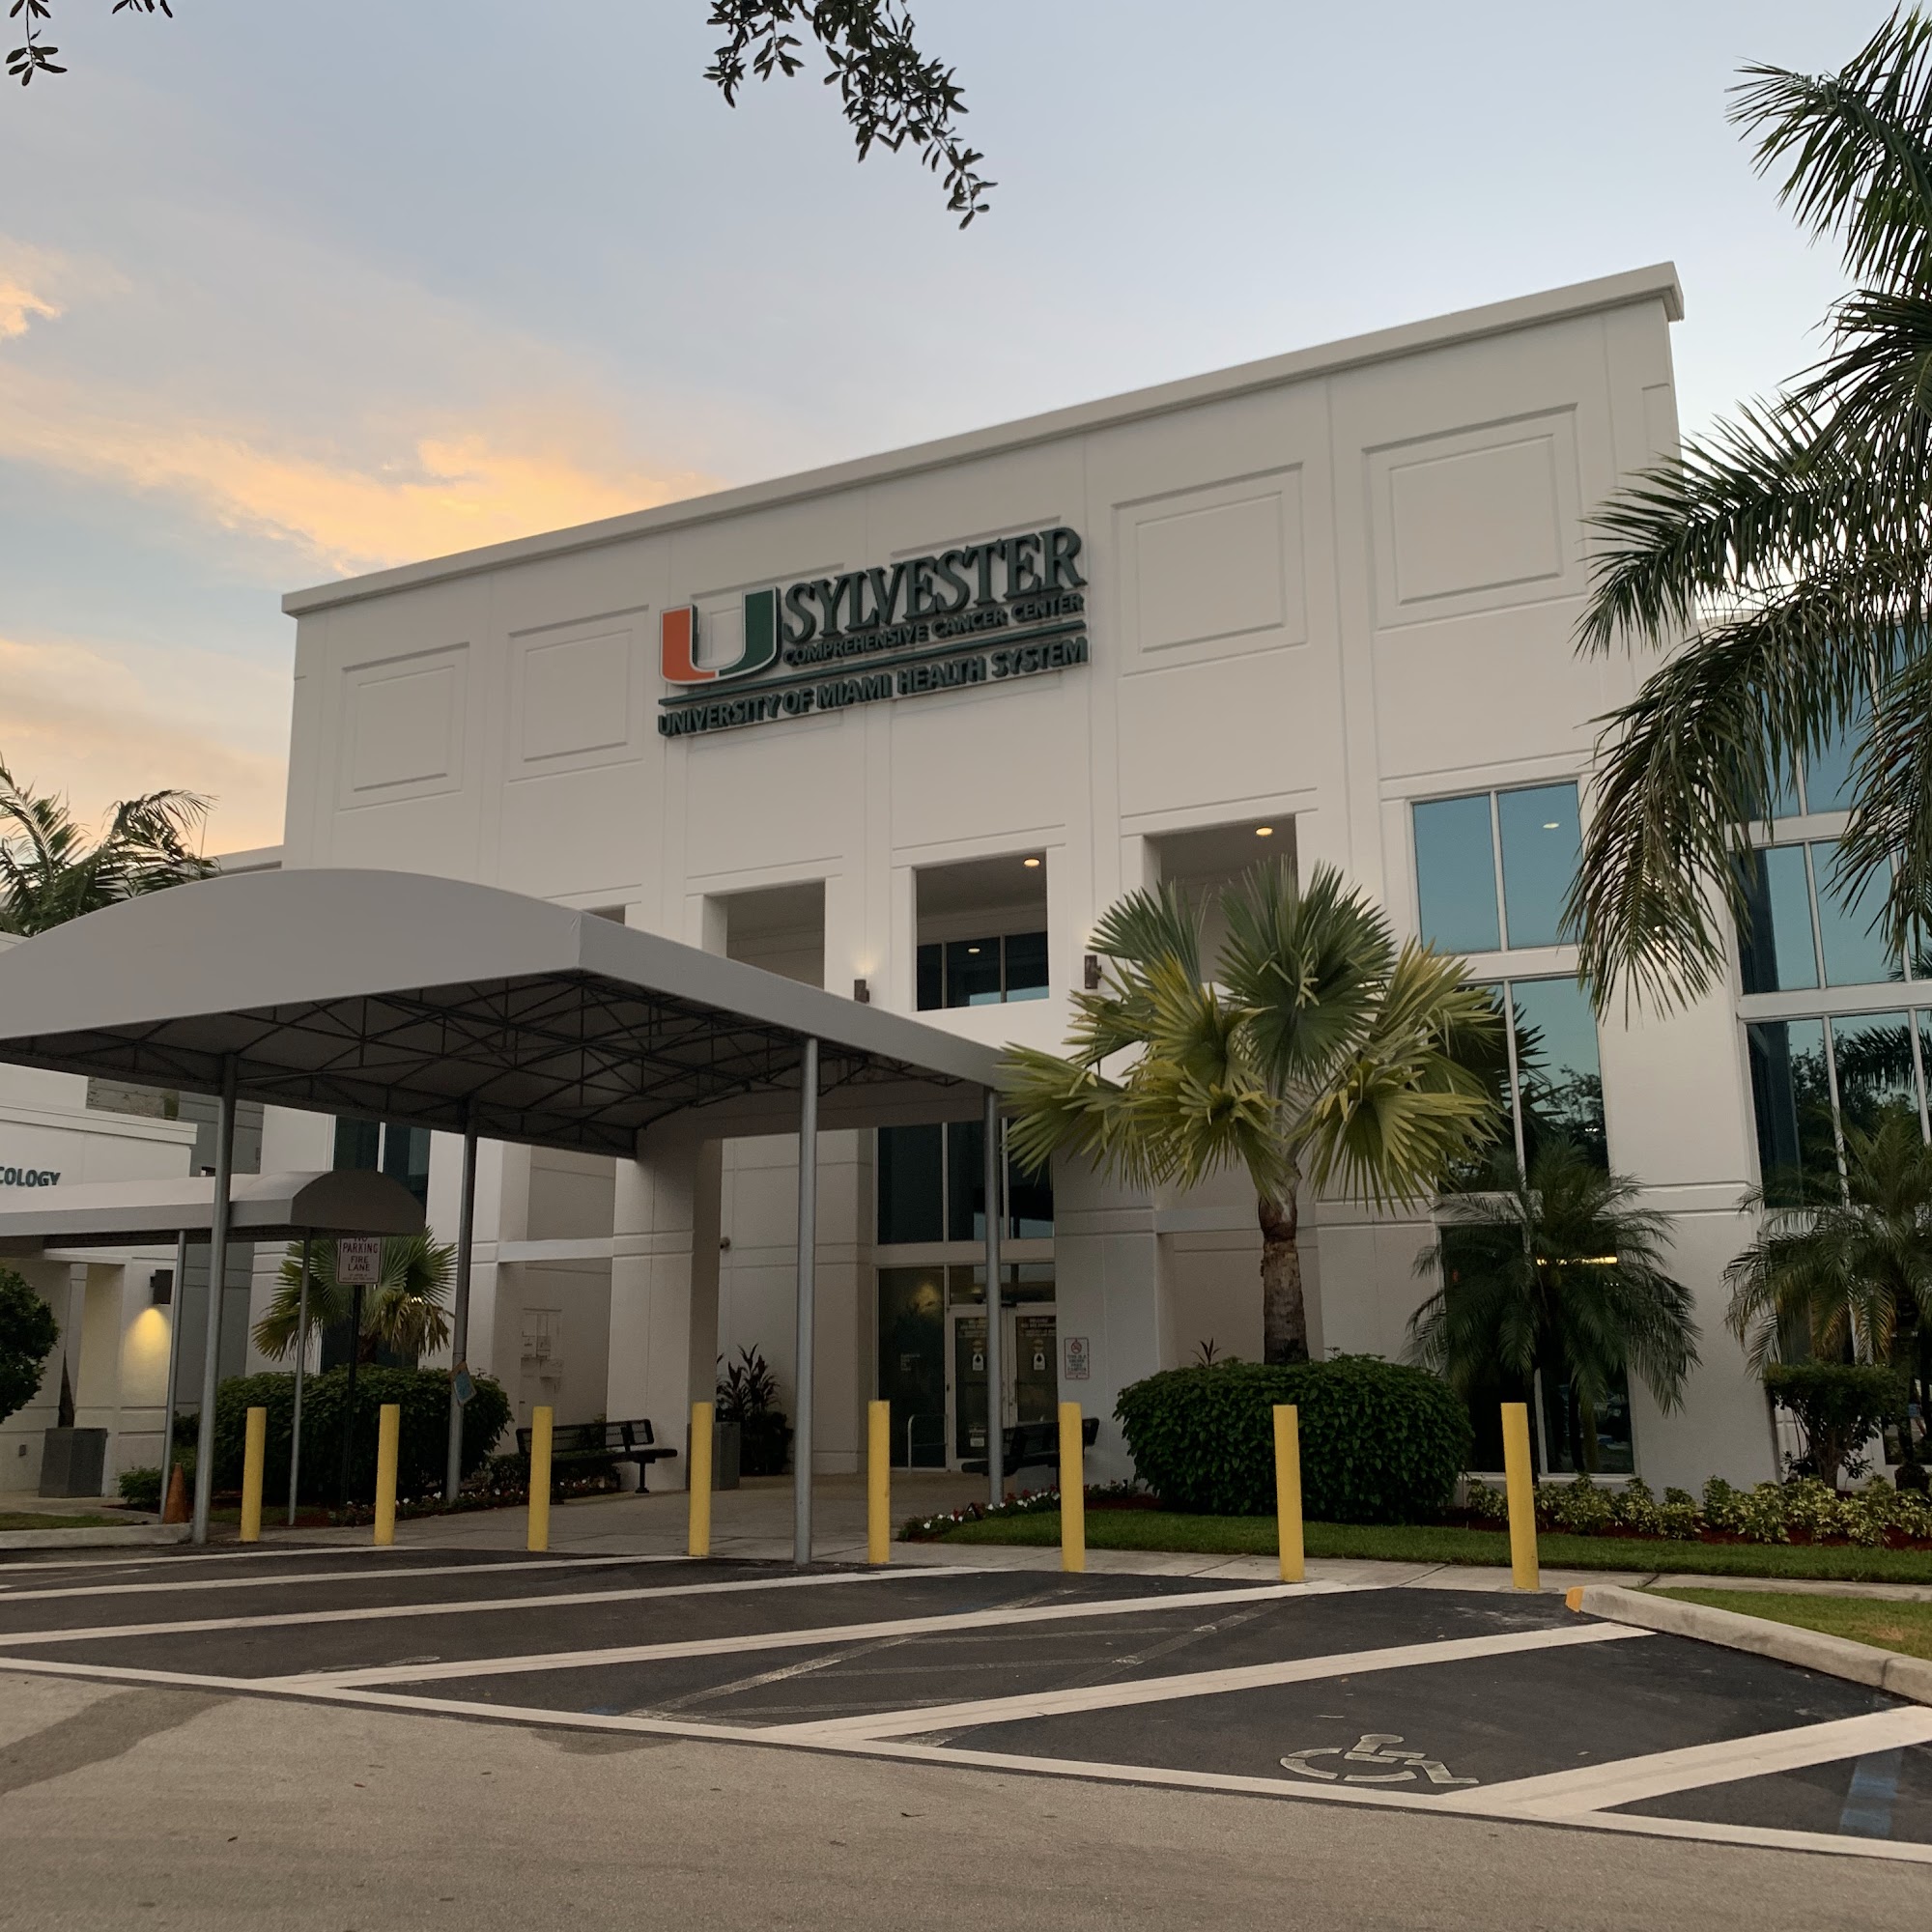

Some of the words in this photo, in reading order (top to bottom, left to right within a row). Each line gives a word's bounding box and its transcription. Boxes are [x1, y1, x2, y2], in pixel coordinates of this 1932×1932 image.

[782, 526, 1088, 643] SYLVESTER
[782, 623, 929, 666] COMPREHENSIVE
[931, 607, 1008, 639] CANCER
[1011, 592, 1085, 623] CENTER
[660, 586, 781, 685] U
[658, 694, 781, 736] UNIVERSITY
[782, 687, 814, 715] OF
[816, 671, 893, 710] MIAMI
[897, 656, 986, 695] HEALTH
[991, 637, 1088, 677] SYSTEM
[343, 1242, 378, 1254] PARKING
